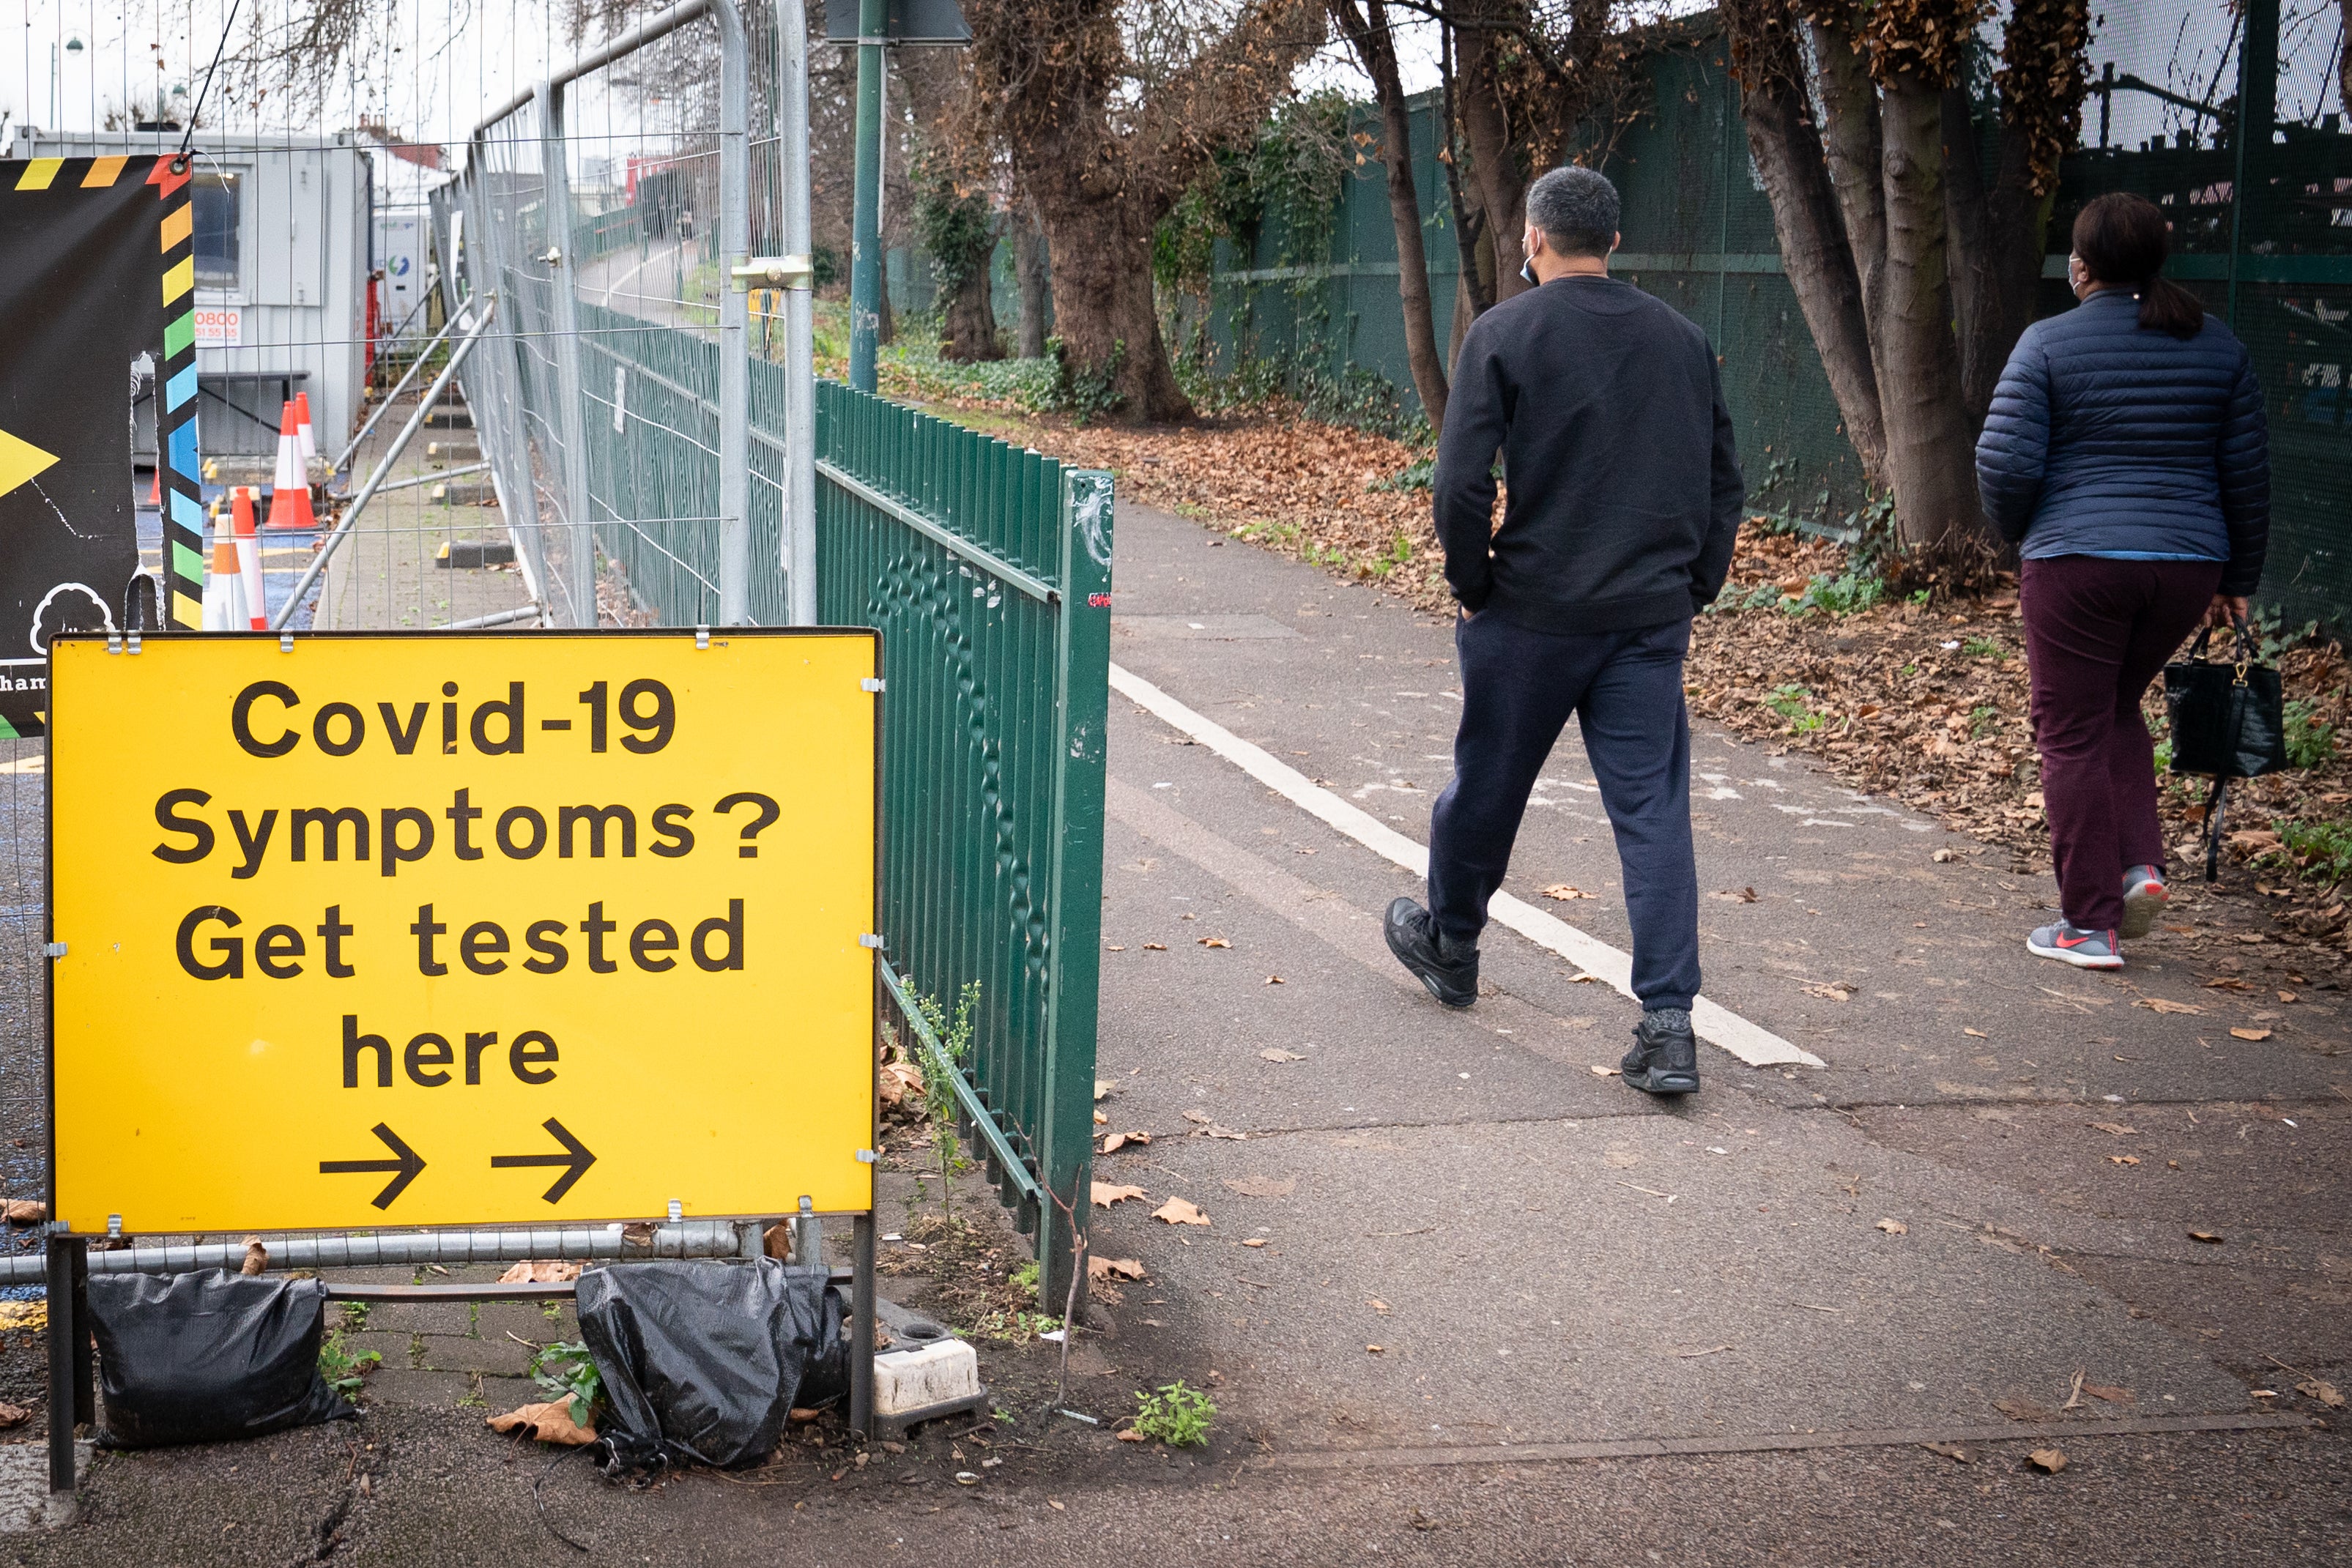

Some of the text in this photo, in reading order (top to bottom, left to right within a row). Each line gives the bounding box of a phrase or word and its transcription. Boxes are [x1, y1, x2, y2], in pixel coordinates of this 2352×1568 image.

[195, 313, 238, 326] 0800
[232, 679, 675, 758] Covid-19
[152, 788, 780, 879] Symptoms?
[177, 899, 744, 980] Get tested
[343, 1015, 559, 1088] here
